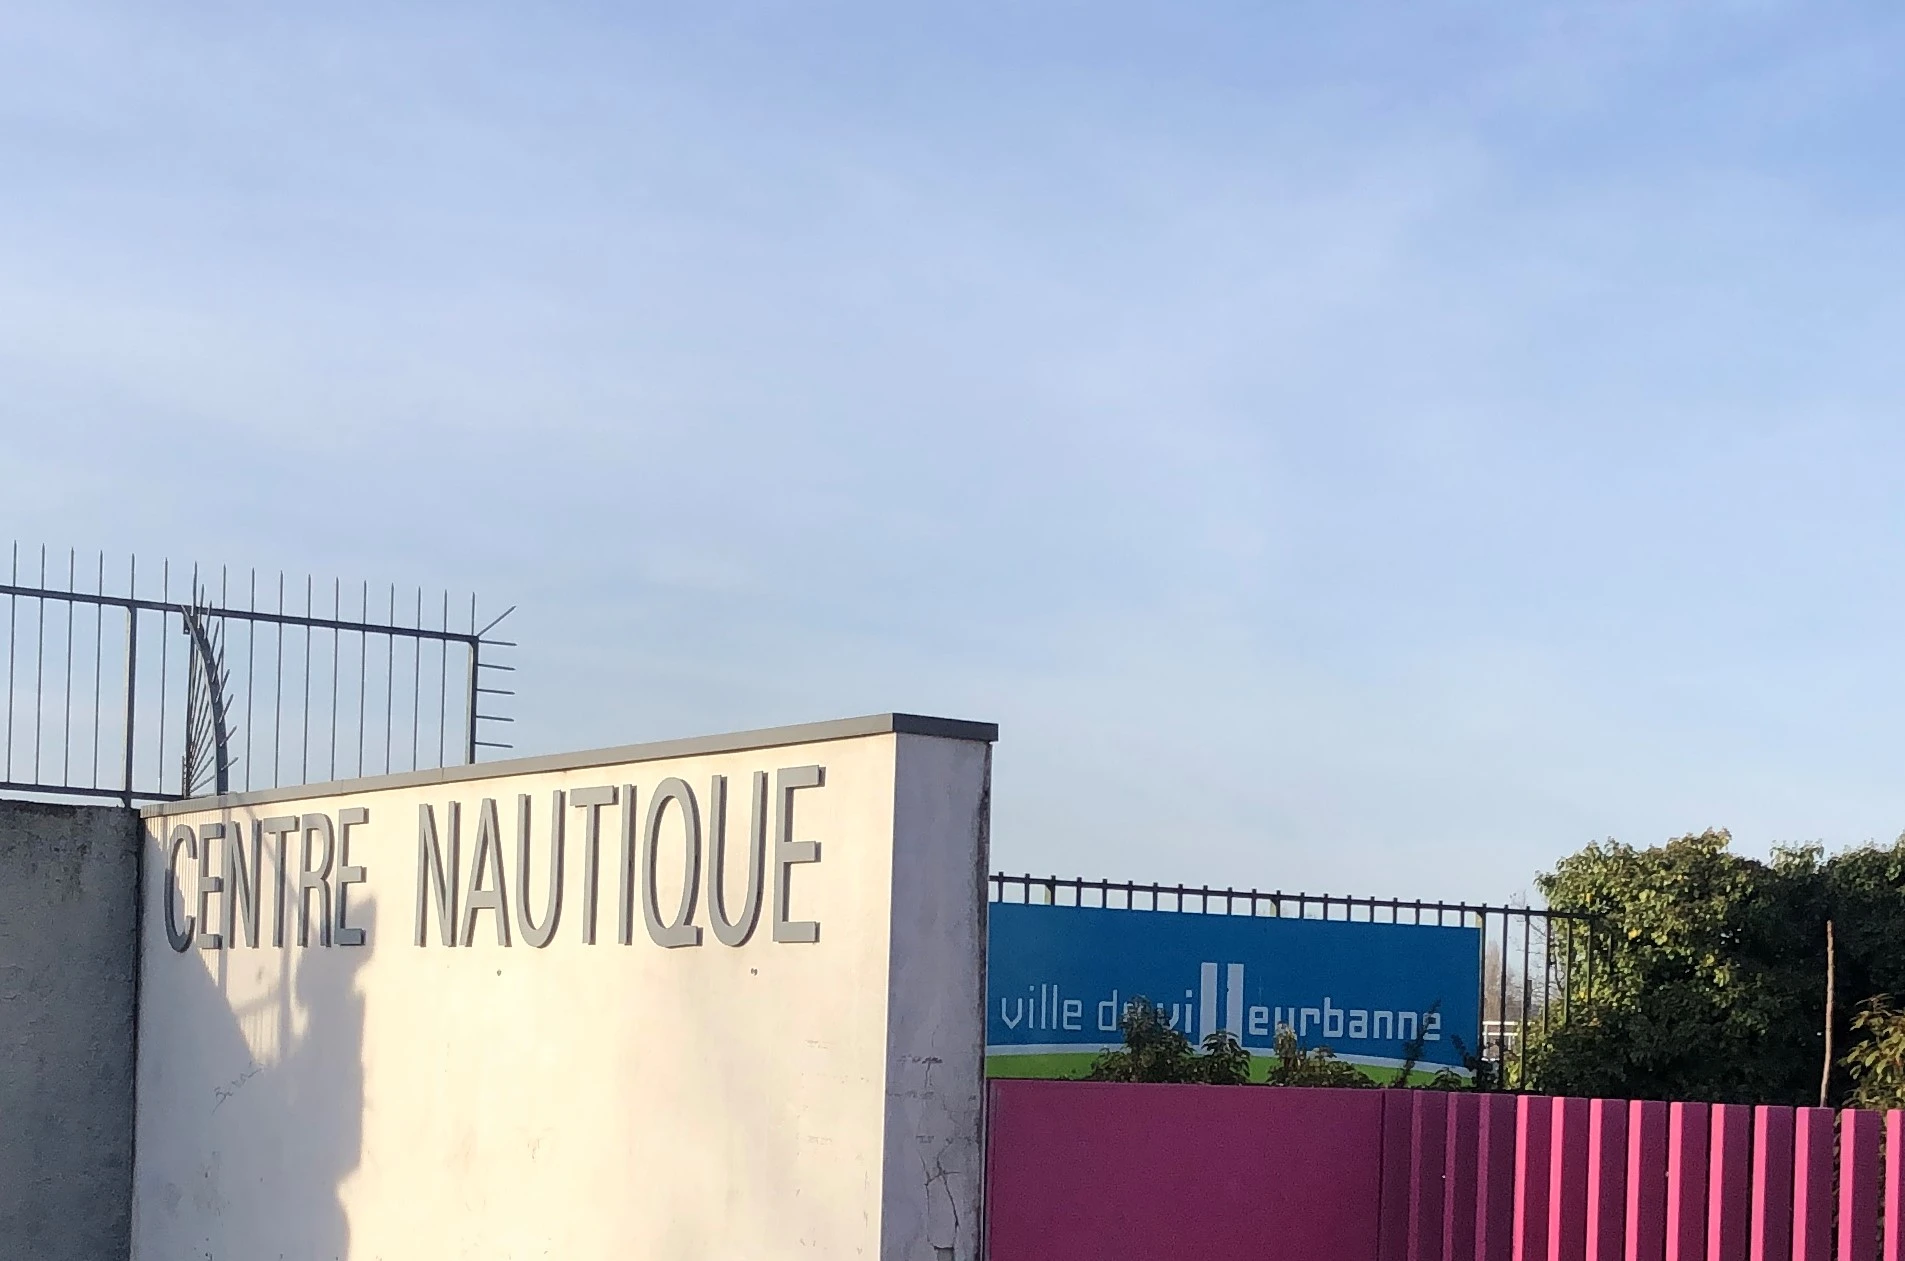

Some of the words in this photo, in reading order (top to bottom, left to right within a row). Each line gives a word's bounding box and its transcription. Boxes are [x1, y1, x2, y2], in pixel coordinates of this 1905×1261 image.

[164, 806, 369, 953] CENTRE
[414, 764, 826, 950] NAUTIQUE
[1001, 983, 1082, 1031] ville
